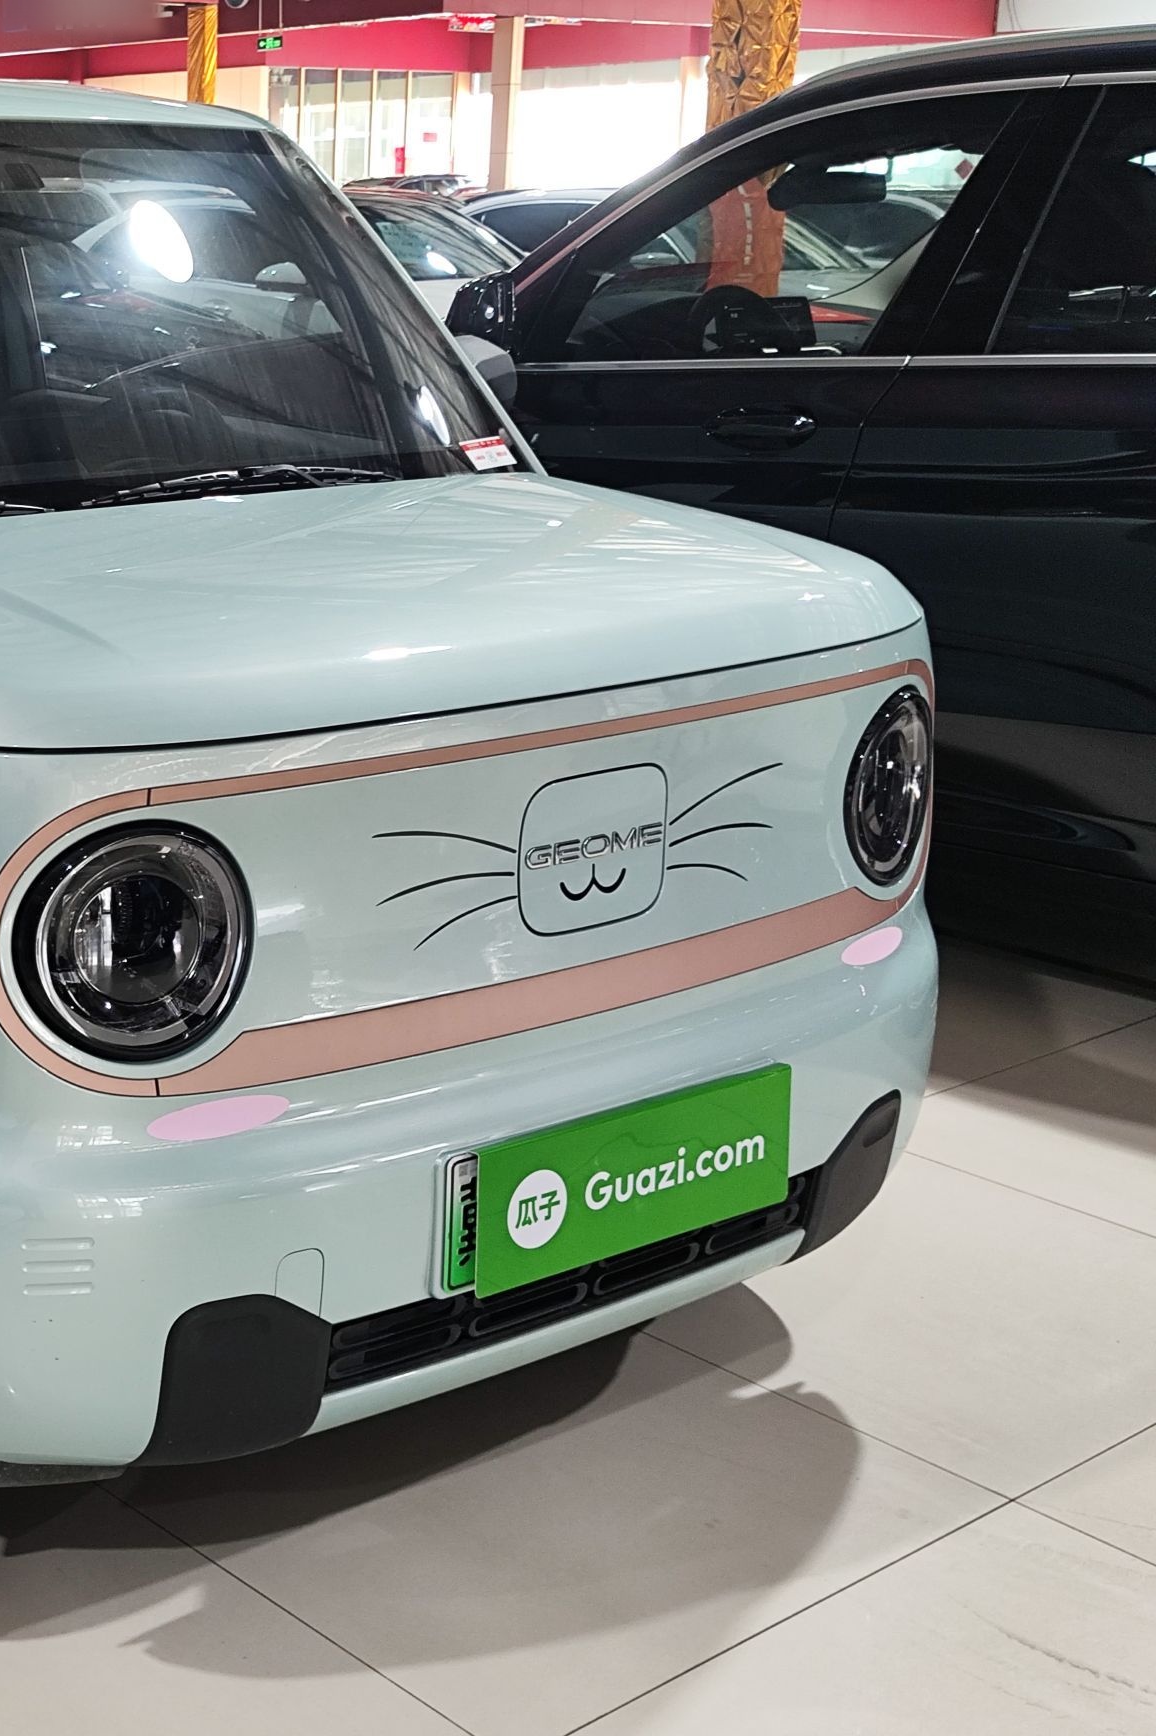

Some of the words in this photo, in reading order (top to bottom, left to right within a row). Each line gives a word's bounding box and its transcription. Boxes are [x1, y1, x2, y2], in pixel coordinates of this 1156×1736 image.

[525, 822, 663, 870] GEOME
[584, 1134, 765, 1210] Guazi.com
[515, 1190, 560, 1229] 瓜子
